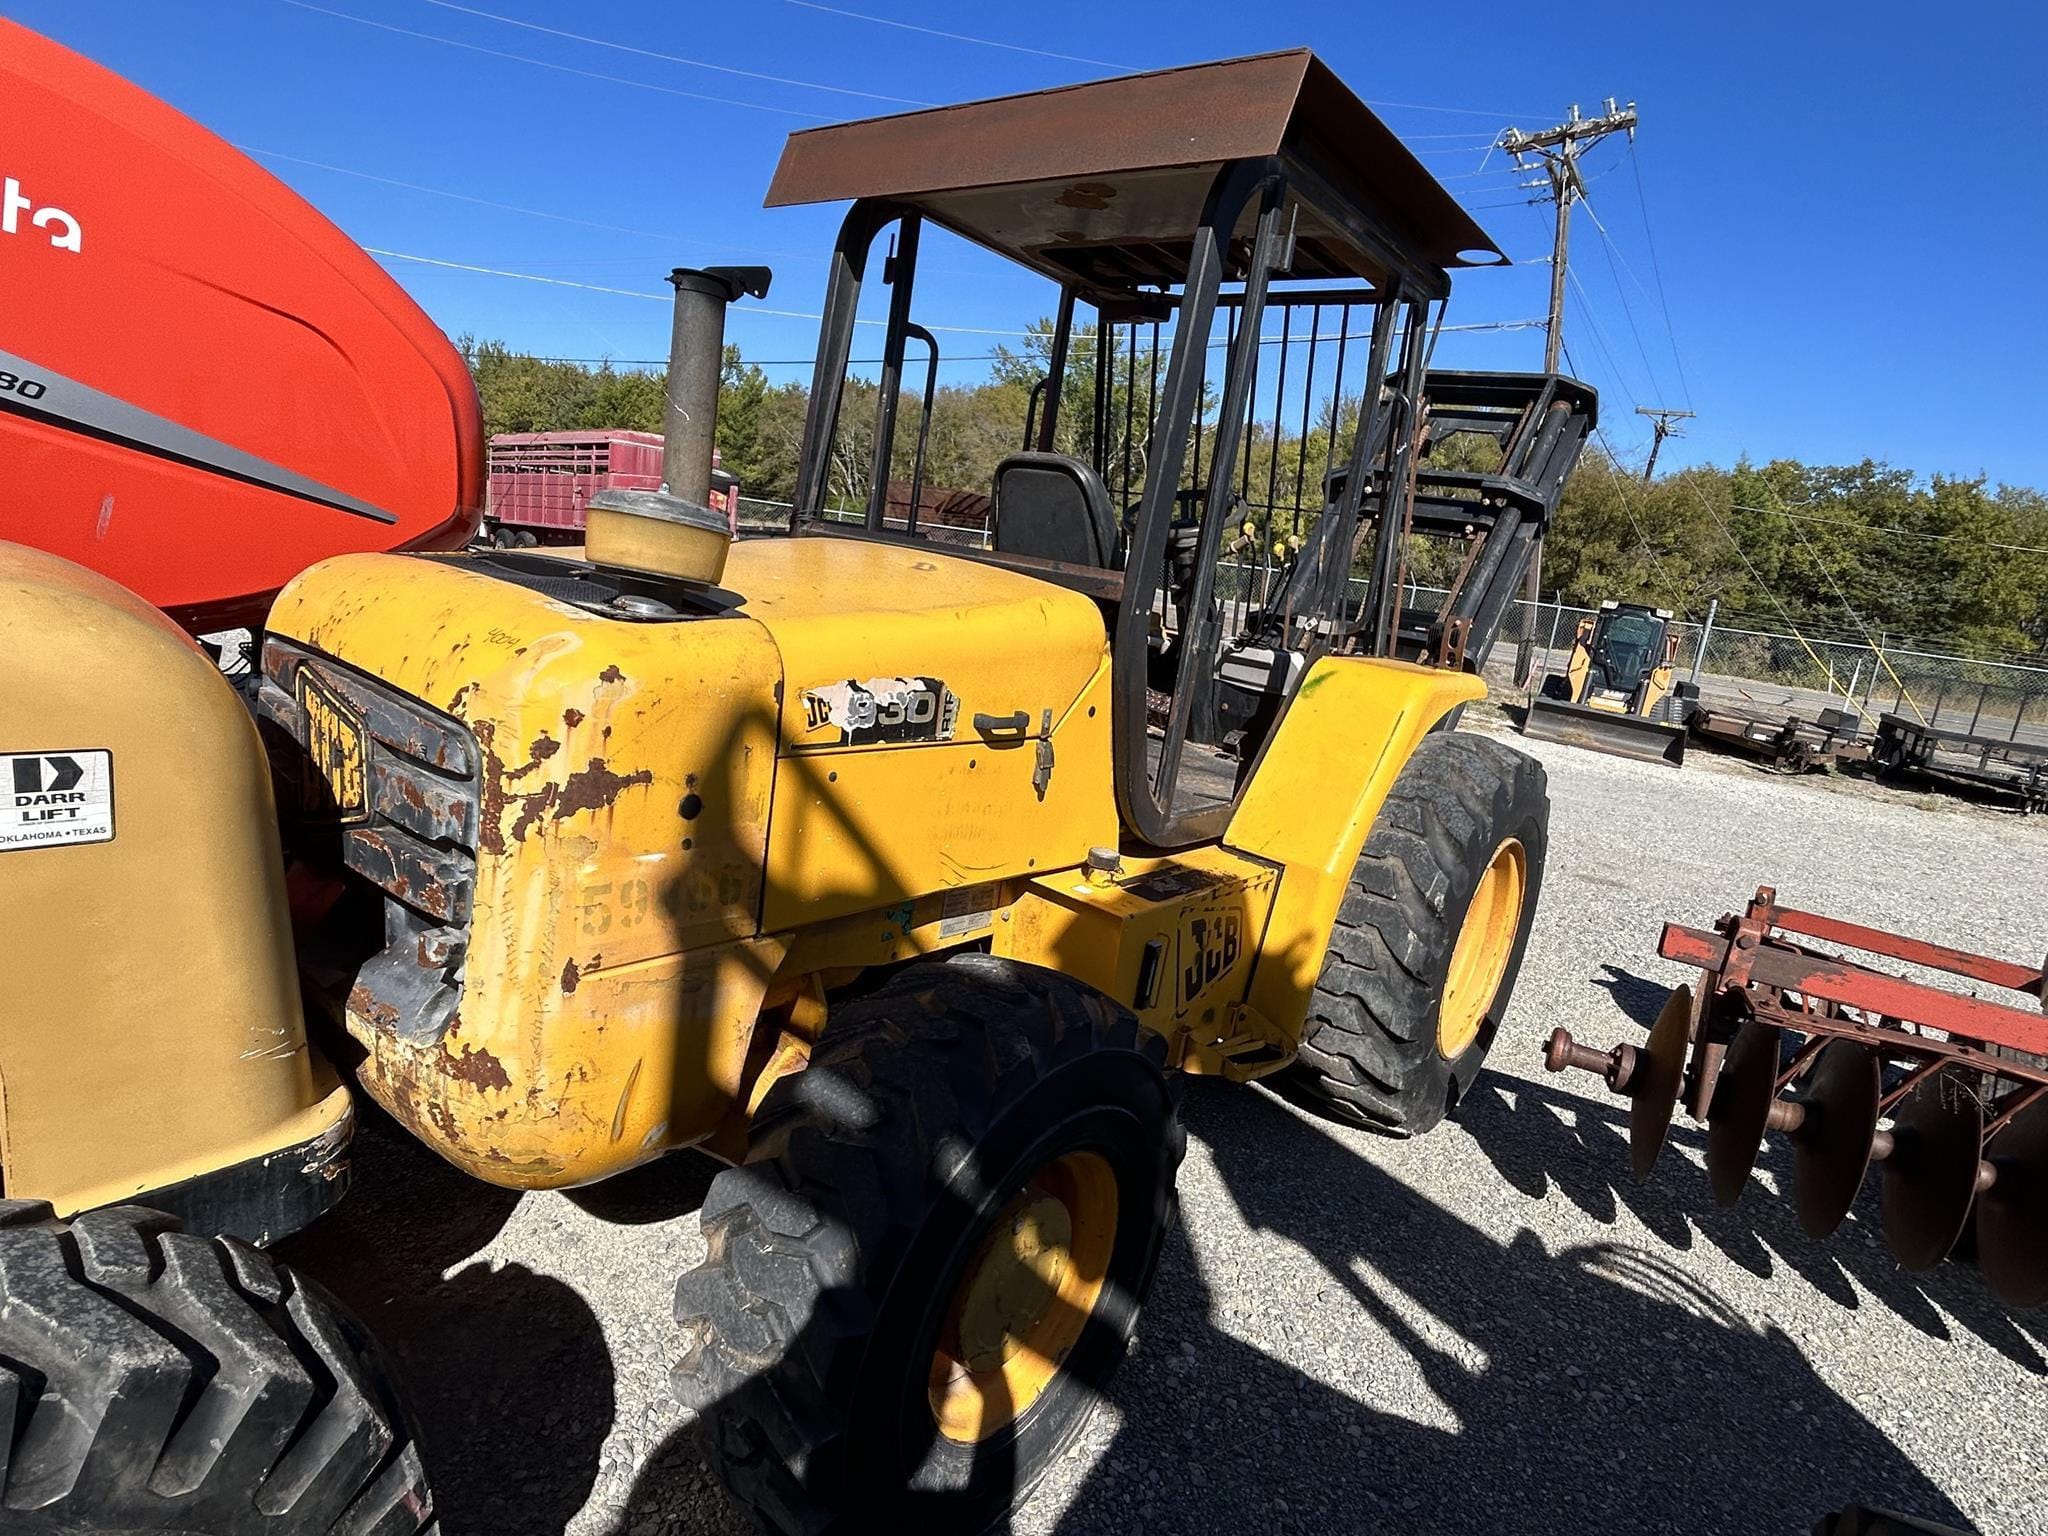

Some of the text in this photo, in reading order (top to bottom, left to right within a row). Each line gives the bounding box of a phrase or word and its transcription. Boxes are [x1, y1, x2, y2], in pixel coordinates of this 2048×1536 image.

[807, 695, 833, 728] JC
[15, 792, 87, 807] DARR
[22, 807, 81, 822] LIFT
[0, 826, 107, 844] OKLAHOMA TEXAS
[1184, 915, 1239, 1002] JCB
